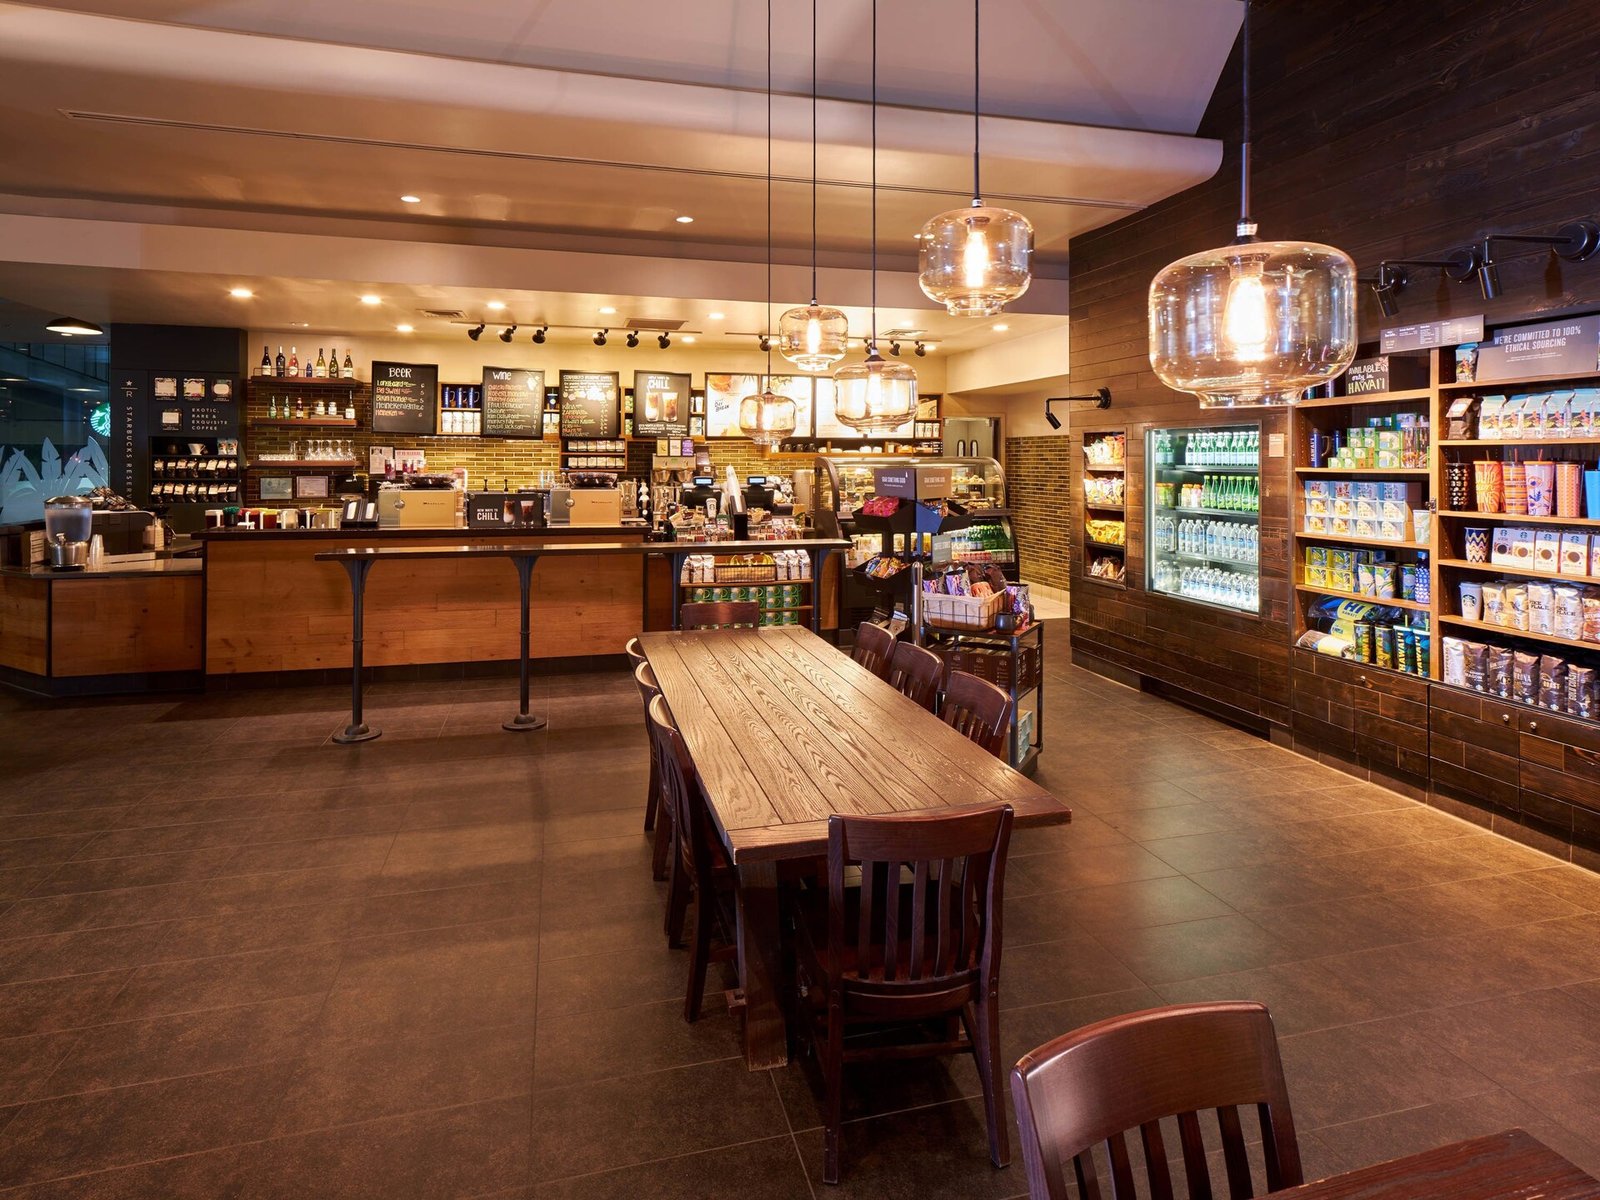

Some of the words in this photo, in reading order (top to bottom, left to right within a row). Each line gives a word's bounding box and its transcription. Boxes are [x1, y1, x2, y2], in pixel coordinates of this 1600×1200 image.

[1494, 335, 1512, 345] WE'RE
[1514, 331, 1550, 343] COMMITTED
[1553, 328, 1561, 337] TO
[1563, 326, 1582, 336] 100%
[1505, 342, 1530, 353] ETHICAL
[1532, 338, 1567, 350] SOURCING
[1349, 364, 1380, 375] AVAILABLE
[477, 512, 499, 520] CHILL
[1344, 601, 1366, 614] HI
